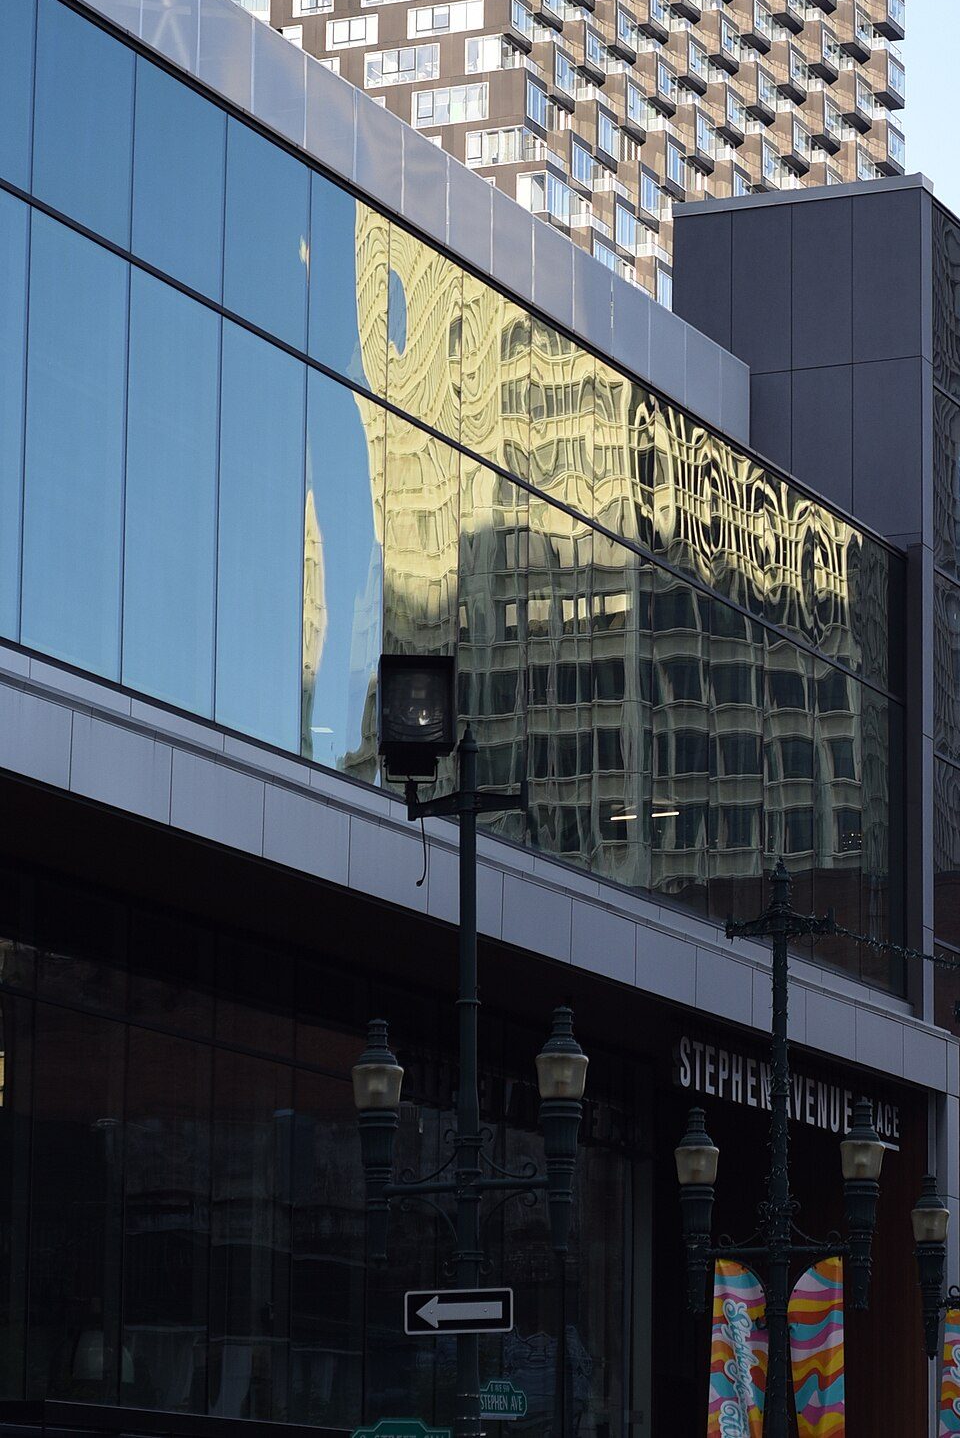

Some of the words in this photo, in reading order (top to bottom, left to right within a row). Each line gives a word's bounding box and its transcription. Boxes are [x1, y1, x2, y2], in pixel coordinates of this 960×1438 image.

[861, 1095, 900, 1139] LACE
[480, 1394, 508, 1411] STEPHEN
[511, 1395, 523, 1411] AVE
